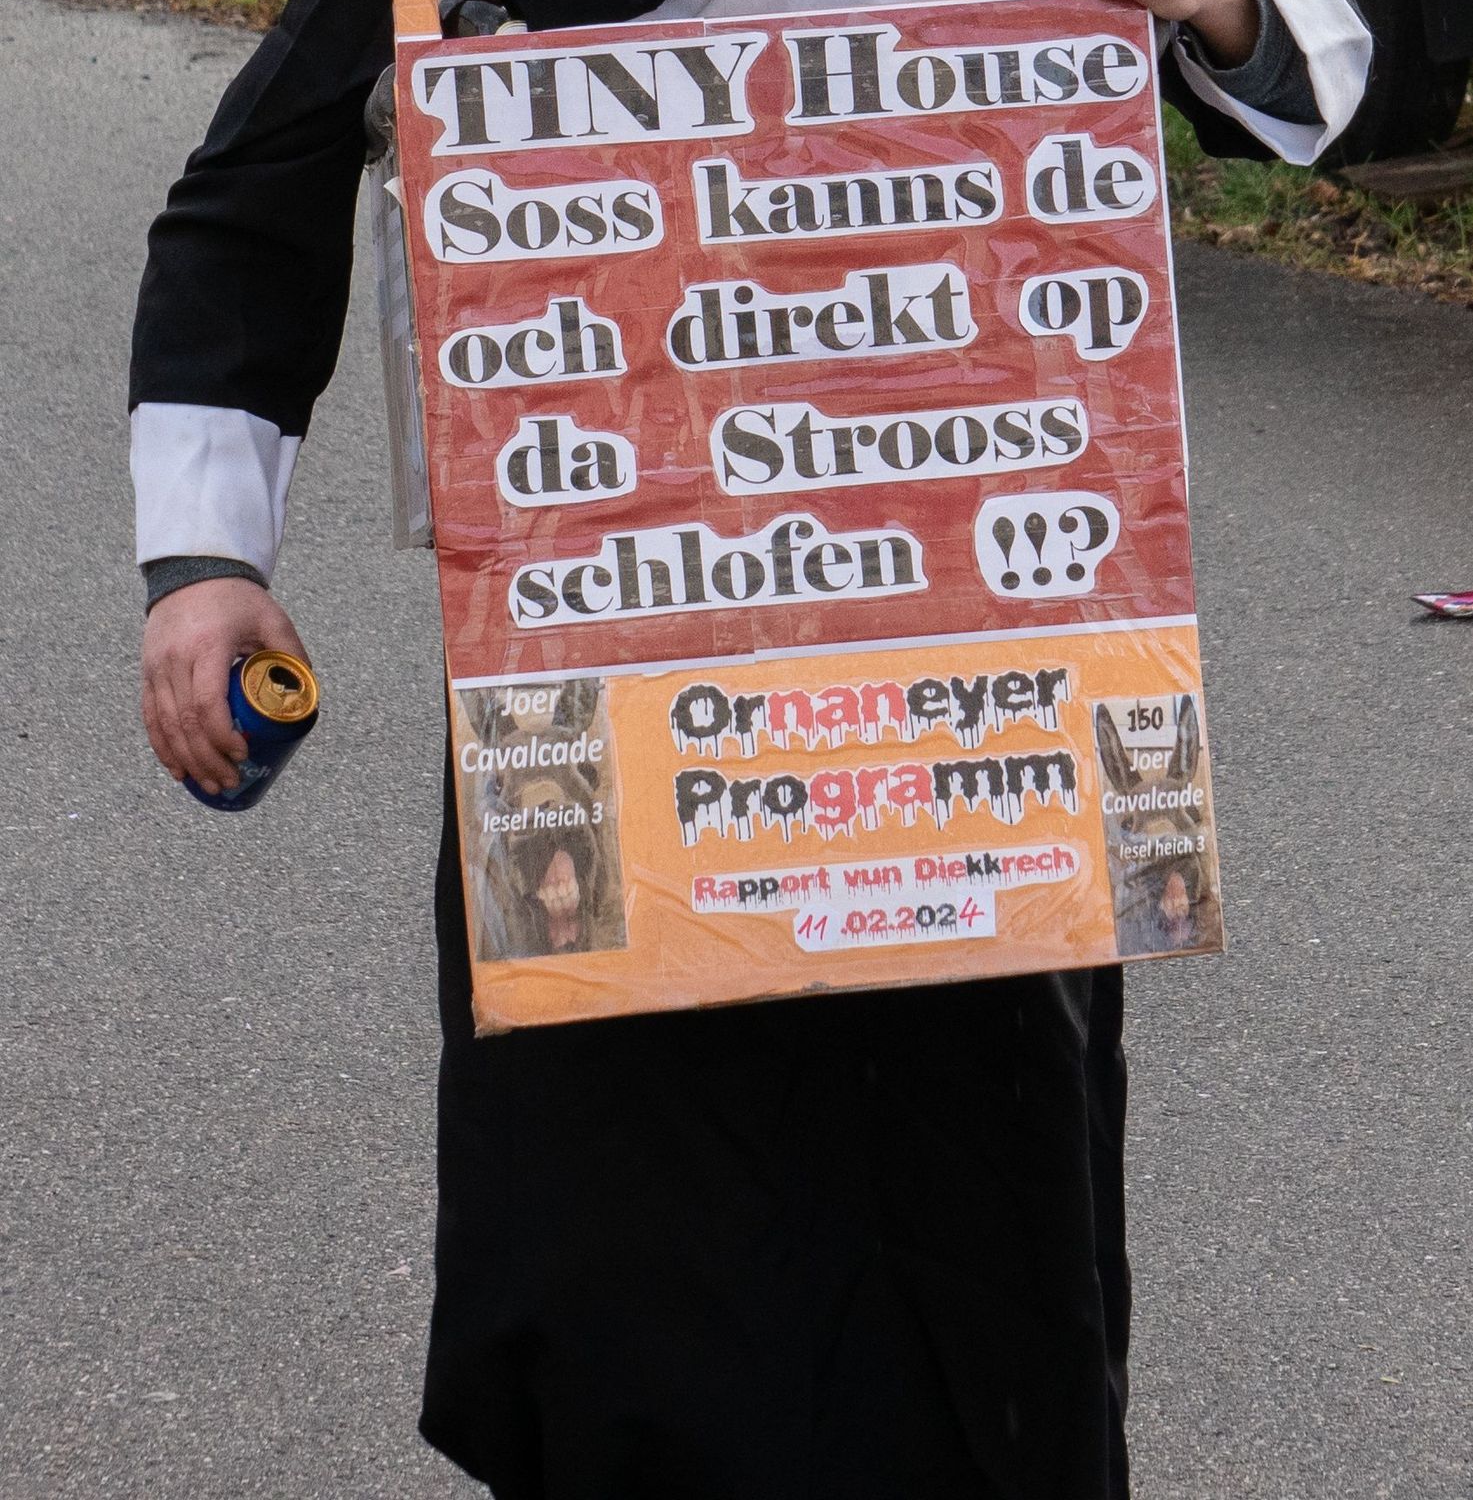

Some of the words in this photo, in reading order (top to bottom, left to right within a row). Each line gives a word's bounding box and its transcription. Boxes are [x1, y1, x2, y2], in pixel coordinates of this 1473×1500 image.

[423, 42, 758, 148] TINY
[792, 30, 1140, 120] House
[438, 178, 656, 258] Soss
[698, 164, 998, 239] kanns
[1029, 140, 1149, 217] de
[447, 301, 625, 384] och
[670, 272, 971, 365] direkt
[1029, 274, 1142, 352] op
[506, 419, 628, 494] da
[723, 404, 1084, 487] Strooss
[516, 519, 924, 620] schlofen
[991, 505, 1111, 591] !!?
[501, 687, 561, 717] Joer
[671, 668, 1070, 758] Ornaneyer
[1127, 706, 1164, 732] 150
[460, 731, 604, 773] Cavalcade
[1130, 749, 1173, 772] Joer
[533, 803, 586, 829] heich
[592, 802, 603, 825] 3
[675, 752, 1077, 846] Programm
[1102, 782, 1204, 815] Cavalcade
[694, 866, 831, 911] Rapport
[843, 863, 903, 896] vun
[914, 846, 1075, 890] Diekkrech
[1155, 837, 1192, 857] heich
[1196, 835, 1205, 853] 3
